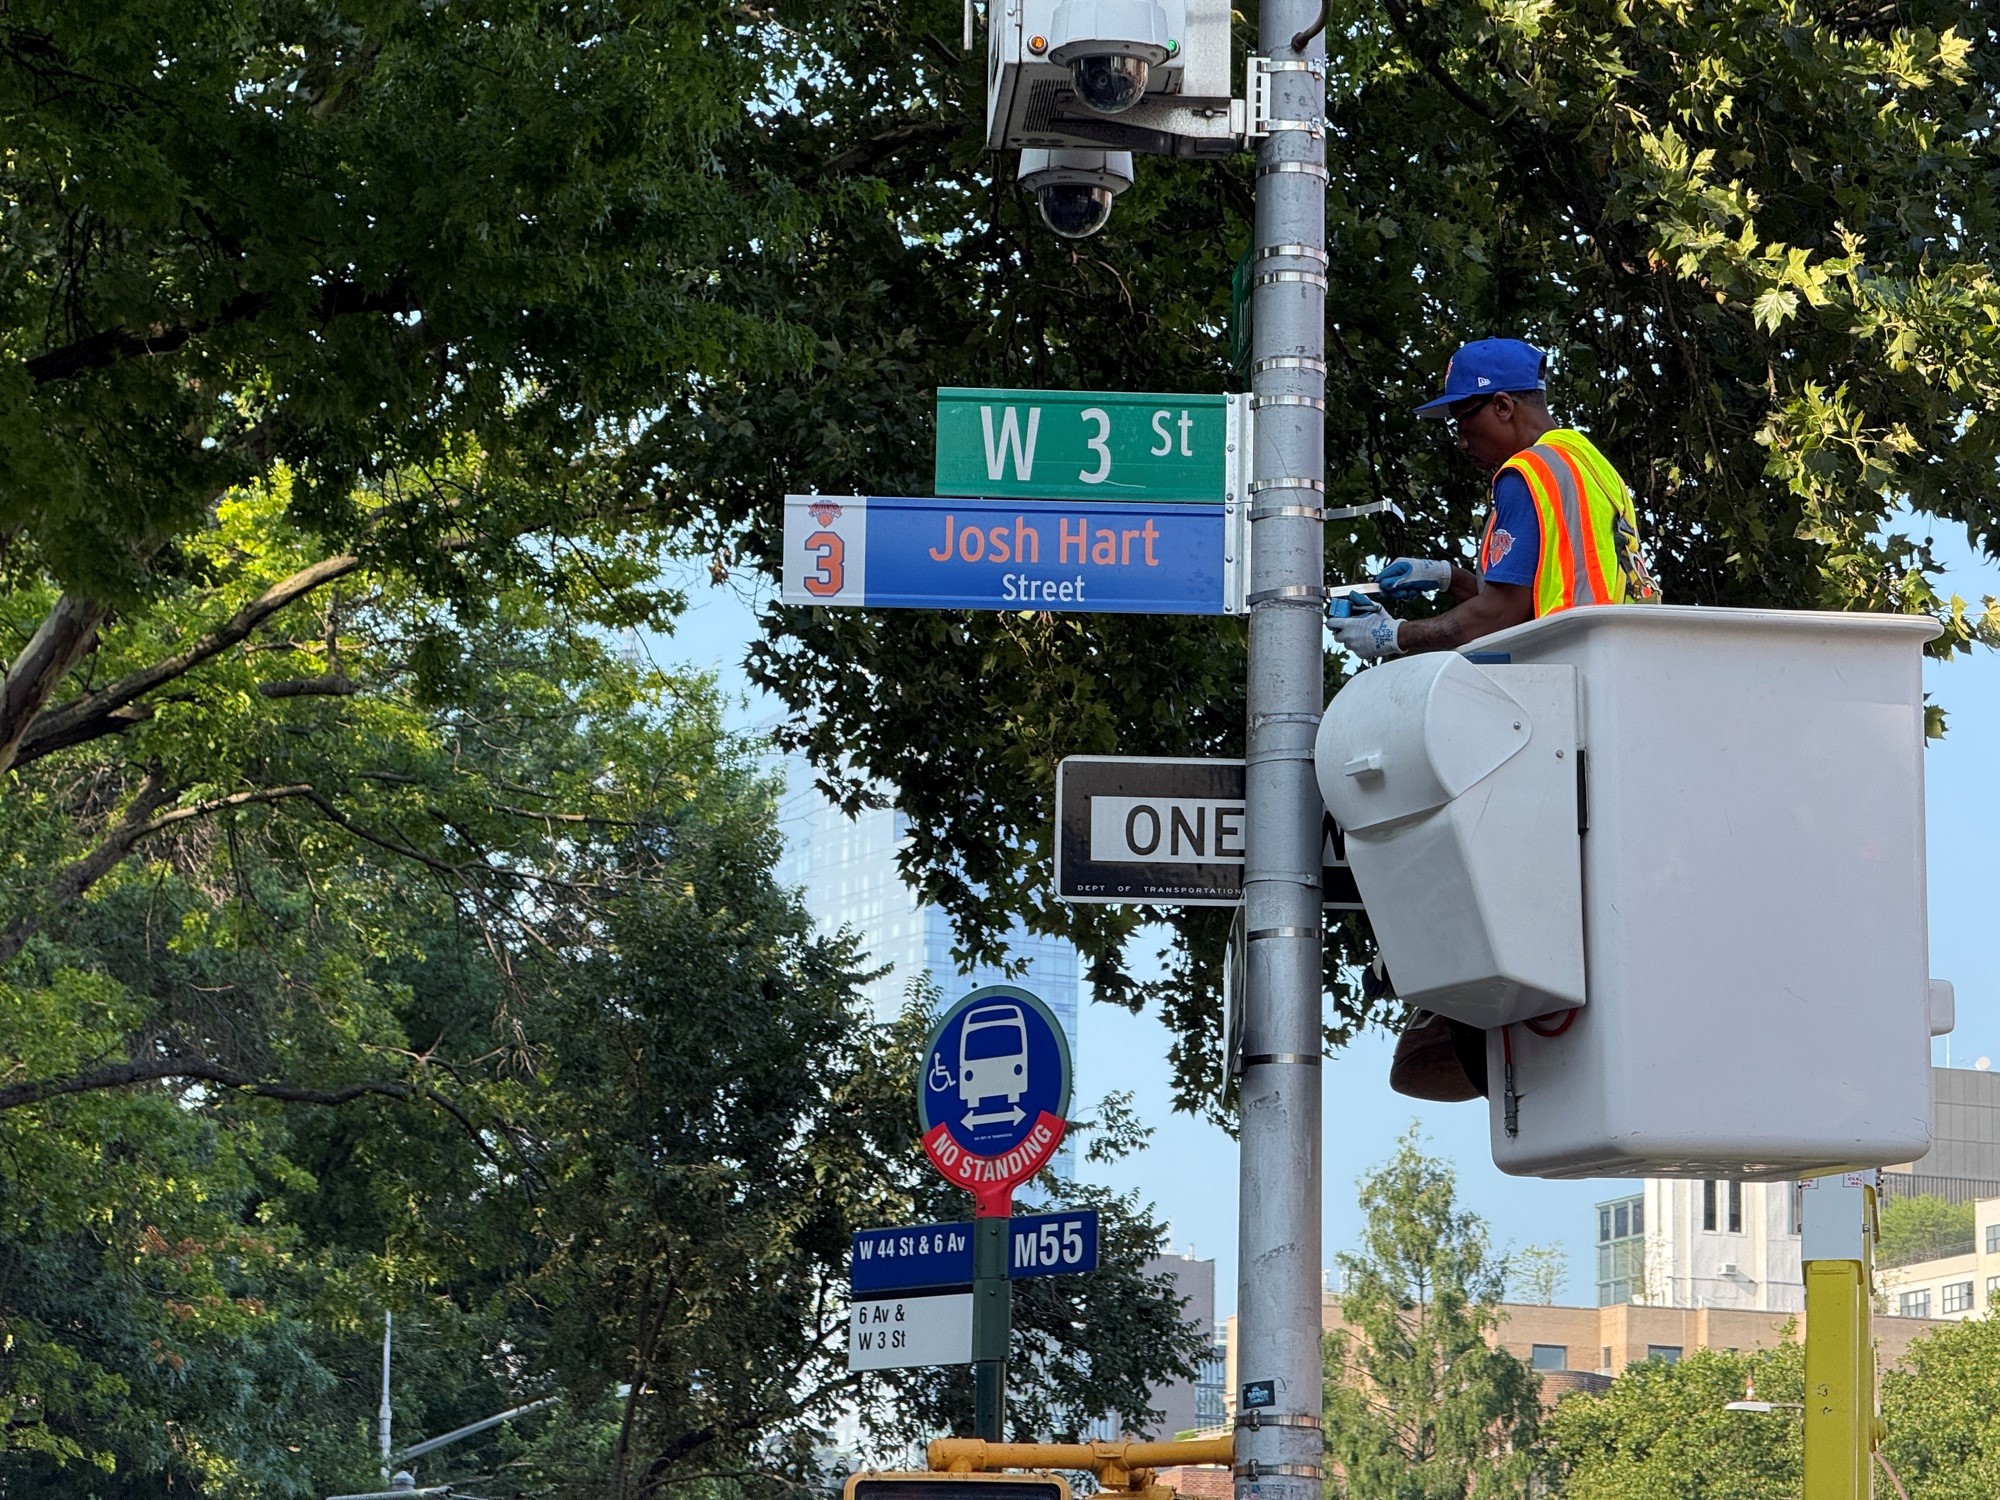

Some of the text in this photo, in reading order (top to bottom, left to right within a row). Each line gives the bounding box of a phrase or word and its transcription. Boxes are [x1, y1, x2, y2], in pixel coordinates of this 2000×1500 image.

[980, 405, 1193, 484] W 3 St
[803, 531, 846, 597] 3
[928, 515, 1160, 566] Josh Hart
[1001, 573, 1085, 602] Street
[1125, 804, 1245, 858] ONE
[1077, 884, 1242, 895] DEPT OF TRANSPORTATION
[932, 1124, 1052, 1182] NO STANDING
[859, 1232, 966, 1260] W 44 St & 6 Av
[1014, 1221, 1084, 1268] M55
[858, 1303, 906, 1324] 6 Av &
[858, 1330, 906, 1350] W 3 St
